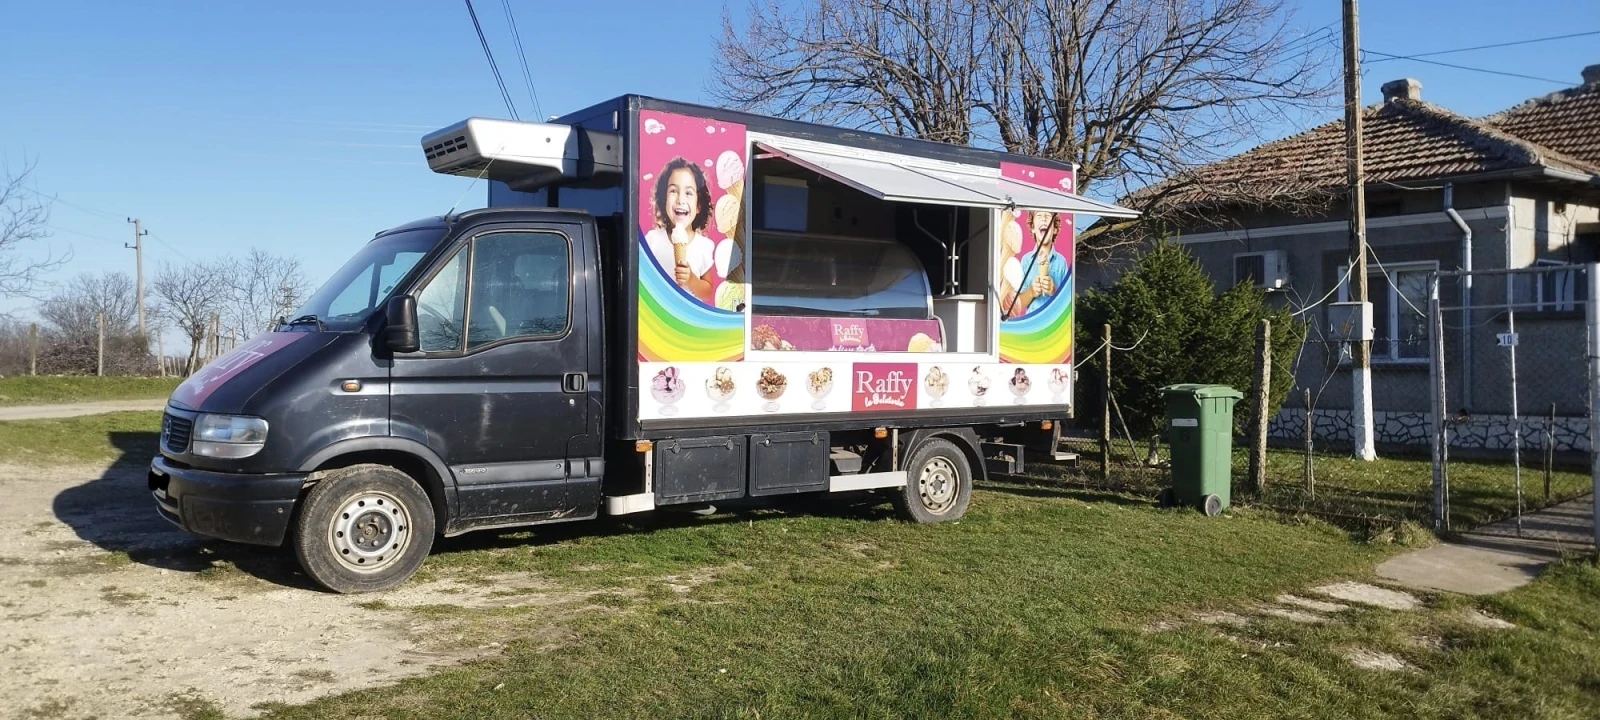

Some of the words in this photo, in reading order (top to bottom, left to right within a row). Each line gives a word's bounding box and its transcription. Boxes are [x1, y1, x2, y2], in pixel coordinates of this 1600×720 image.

[833, 323, 864, 338] Raffy
[1503, 334, 1512, 345] 10
[855, 370, 913, 400] Raffy
